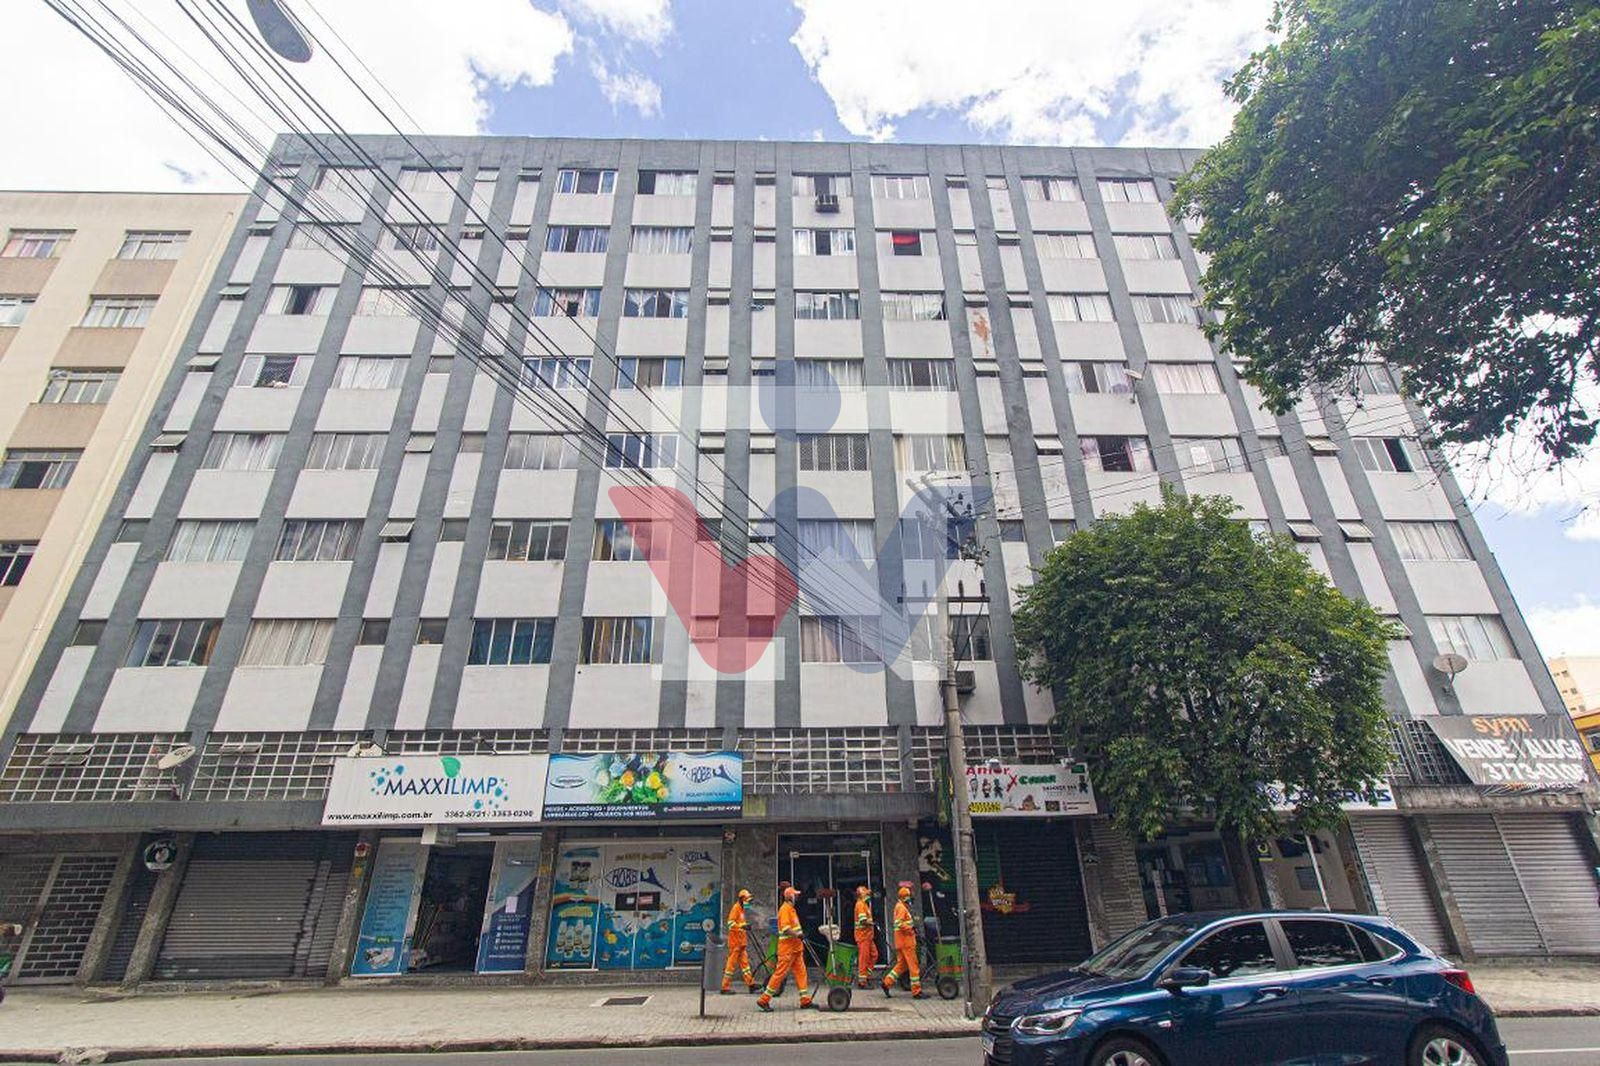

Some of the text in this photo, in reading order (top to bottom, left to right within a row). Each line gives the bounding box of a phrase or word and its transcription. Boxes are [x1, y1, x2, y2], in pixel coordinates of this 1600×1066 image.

[1444, 738, 1517, 759] VENDE
[1523, 738, 1583, 759] ALUGA
[384, 777, 498, 796] MAXXILIMP
[327, 810, 433, 821] www.maxxilimp.com.br
